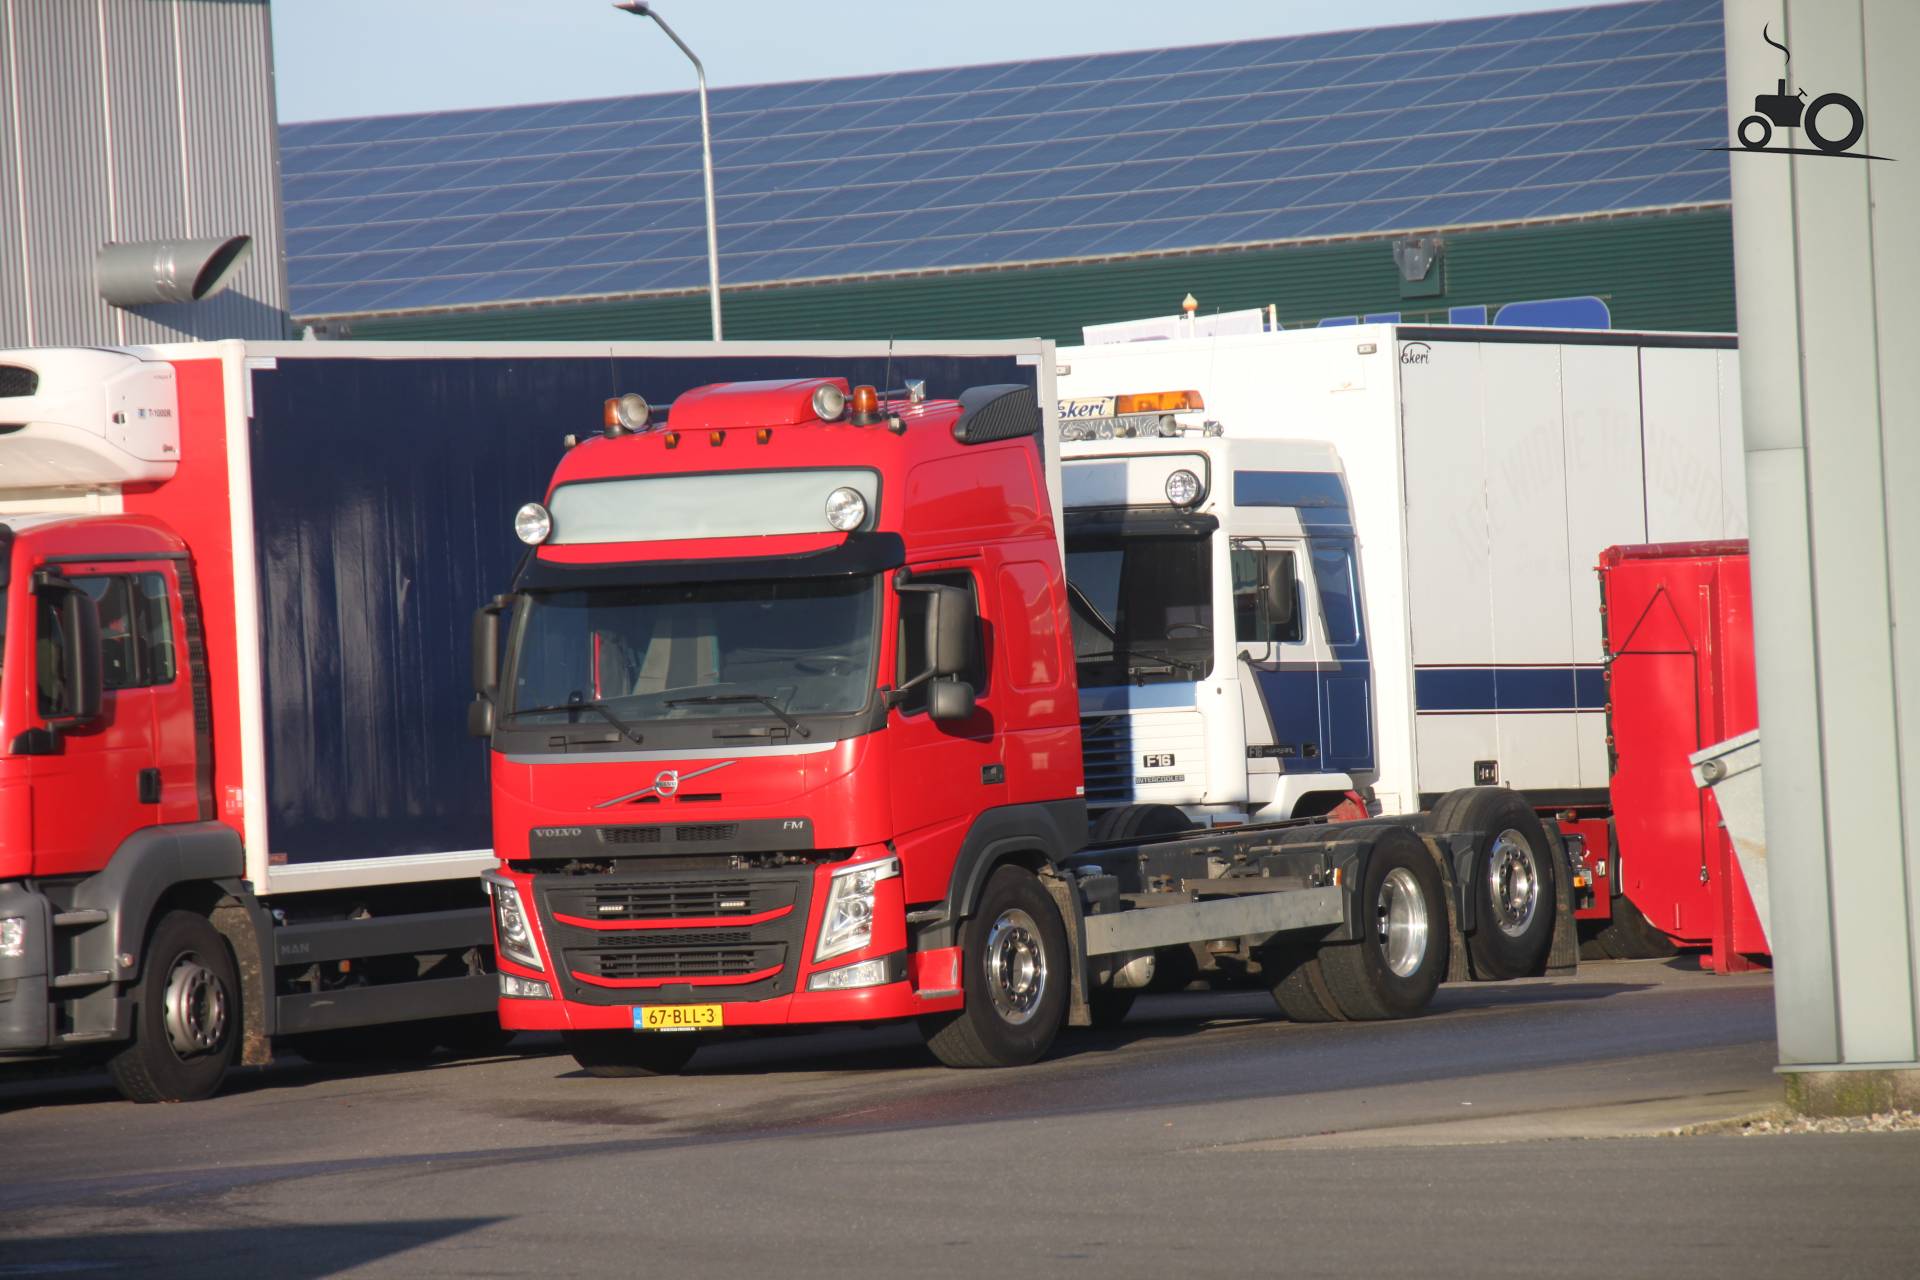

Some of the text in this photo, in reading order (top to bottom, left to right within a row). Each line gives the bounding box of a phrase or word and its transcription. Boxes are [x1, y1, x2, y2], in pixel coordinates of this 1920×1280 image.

[1400, 342, 1431, 364] Ekeri
[1147, 754, 1171, 767] F16
[1135, 775, 1185, 784] INTERCOOLER
[783, 820, 803, 829] FM
[536, 828, 581, 837] VOLVO
[281, 943, 310, 954] MAN
[649, 1008, 715, 1024] 67-BLL-3
